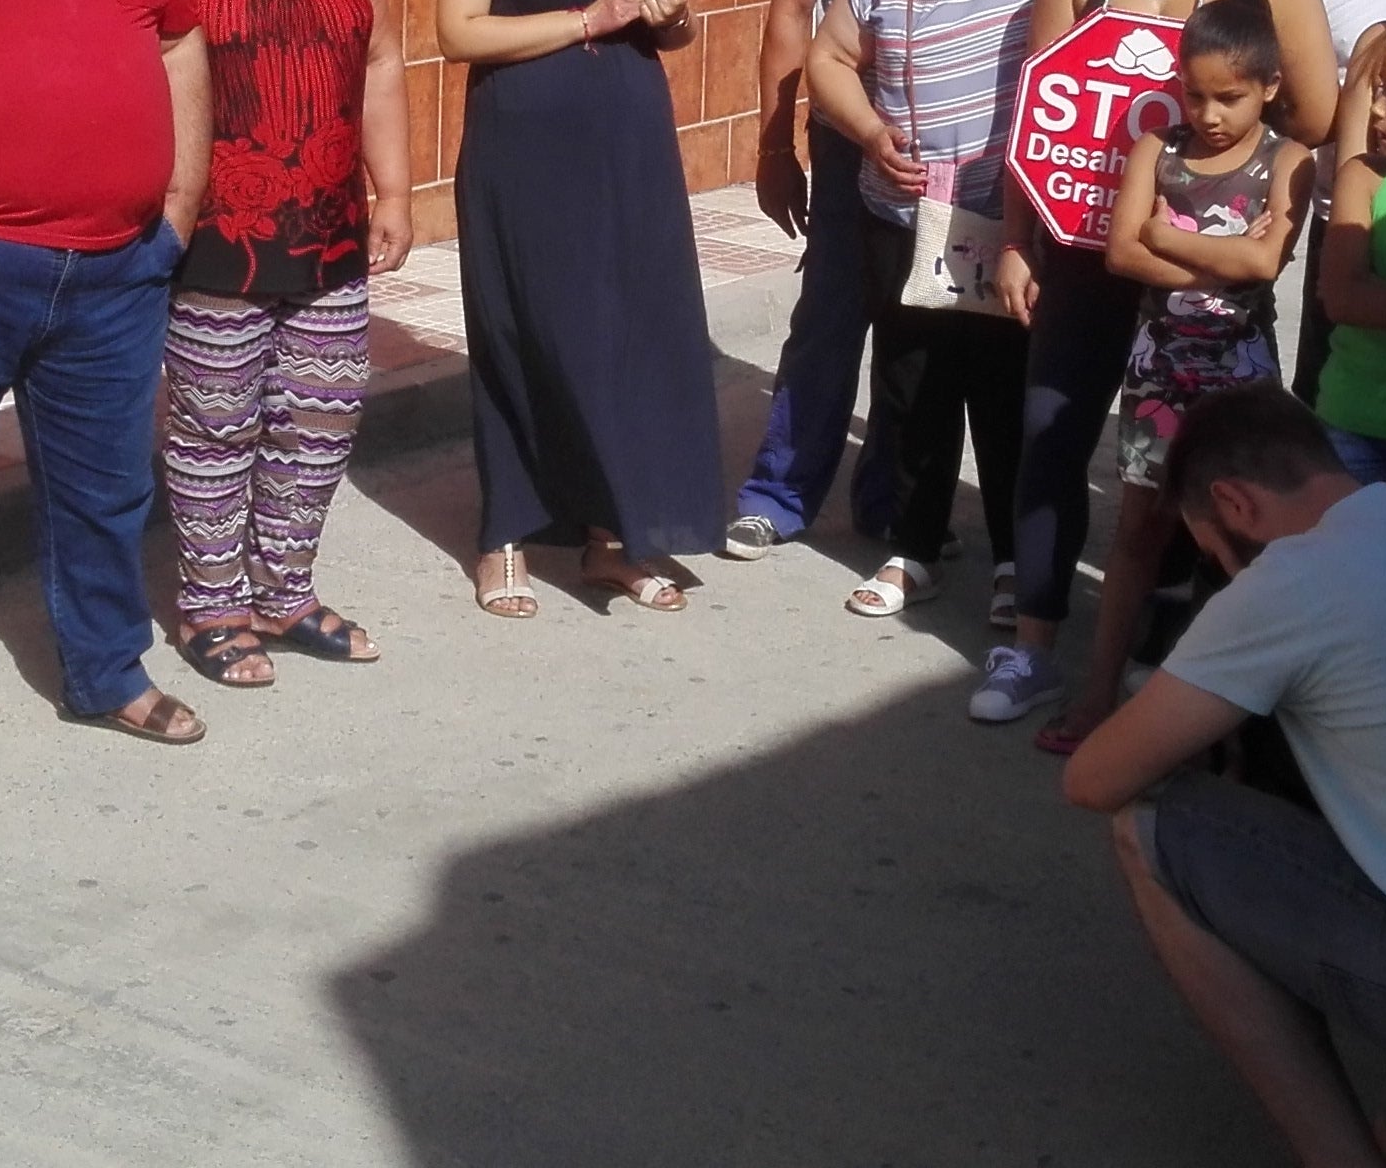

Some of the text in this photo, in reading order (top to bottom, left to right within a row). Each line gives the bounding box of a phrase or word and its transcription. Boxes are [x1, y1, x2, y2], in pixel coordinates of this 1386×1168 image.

[1031, 72, 1182, 143] STO
[1025, 132, 1126, 176] Desah
[1045, 170, 1113, 209] Gran
[1081, 211, 1111, 233] 15
